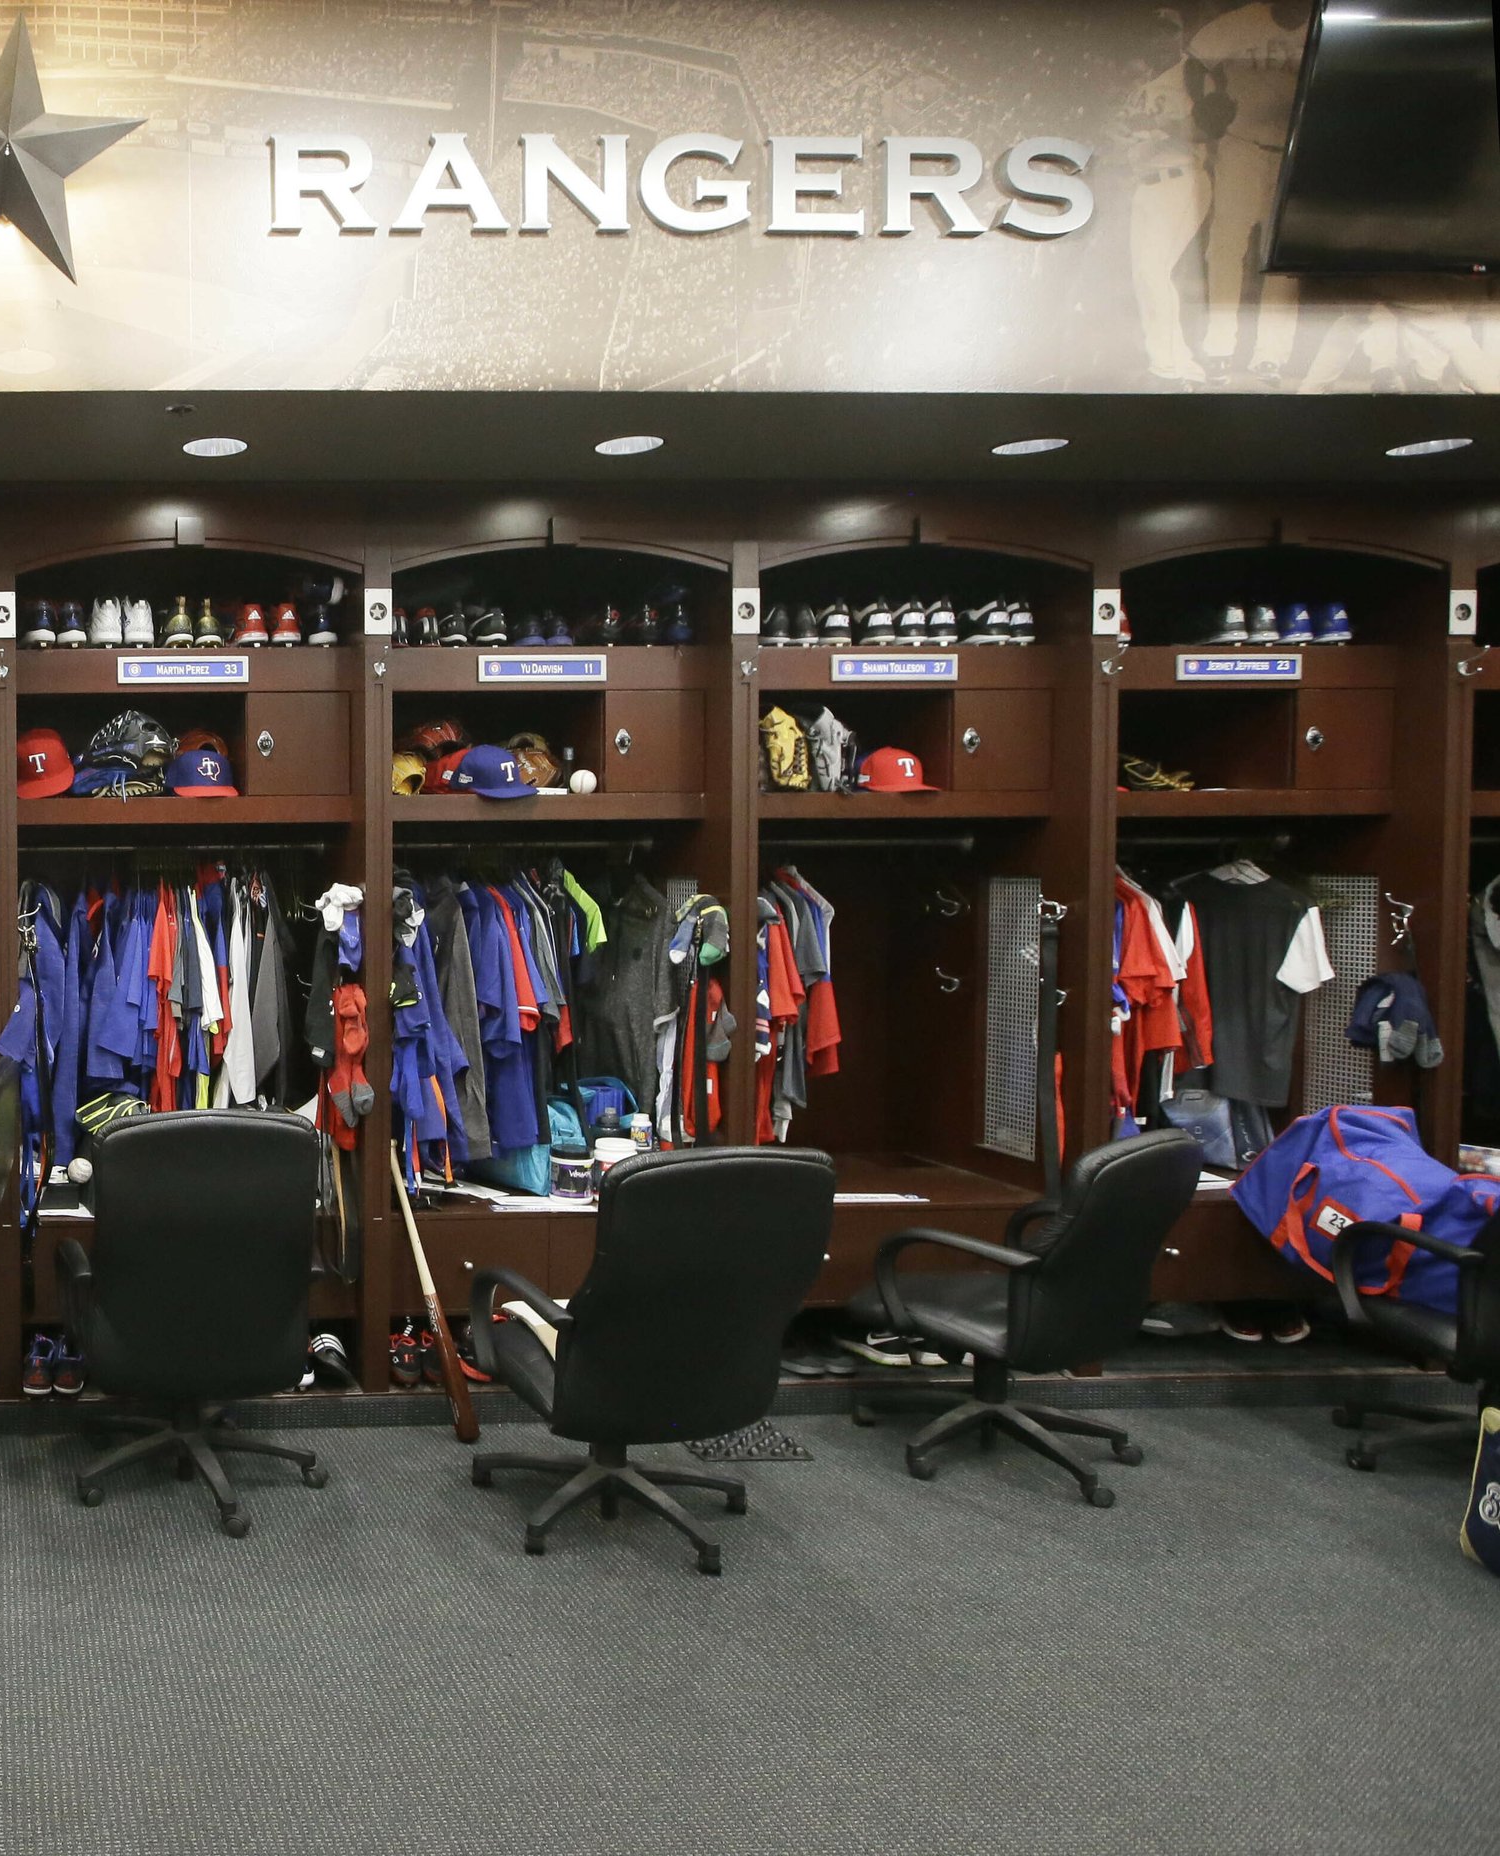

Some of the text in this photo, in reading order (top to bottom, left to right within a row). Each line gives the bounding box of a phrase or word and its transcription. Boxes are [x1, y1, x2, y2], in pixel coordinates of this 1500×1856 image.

[266, 131, 1096, 240] RANGERS
[156, 663, 237, 675] MARTIN PEREZ 33
[520, 663, 593, 674] YU DARVISH 11
[862, 661, 947, 673] SHAWN TOLLESON 37
[1276, 660, 1290, 671] 23
[29, 753, 46, 773] T
[202, 760, 215, 776] T
[500, 761, 515, 782] T
[897, 758, 915, 777] T
[1329, 1213, 1346, 1231] 23
